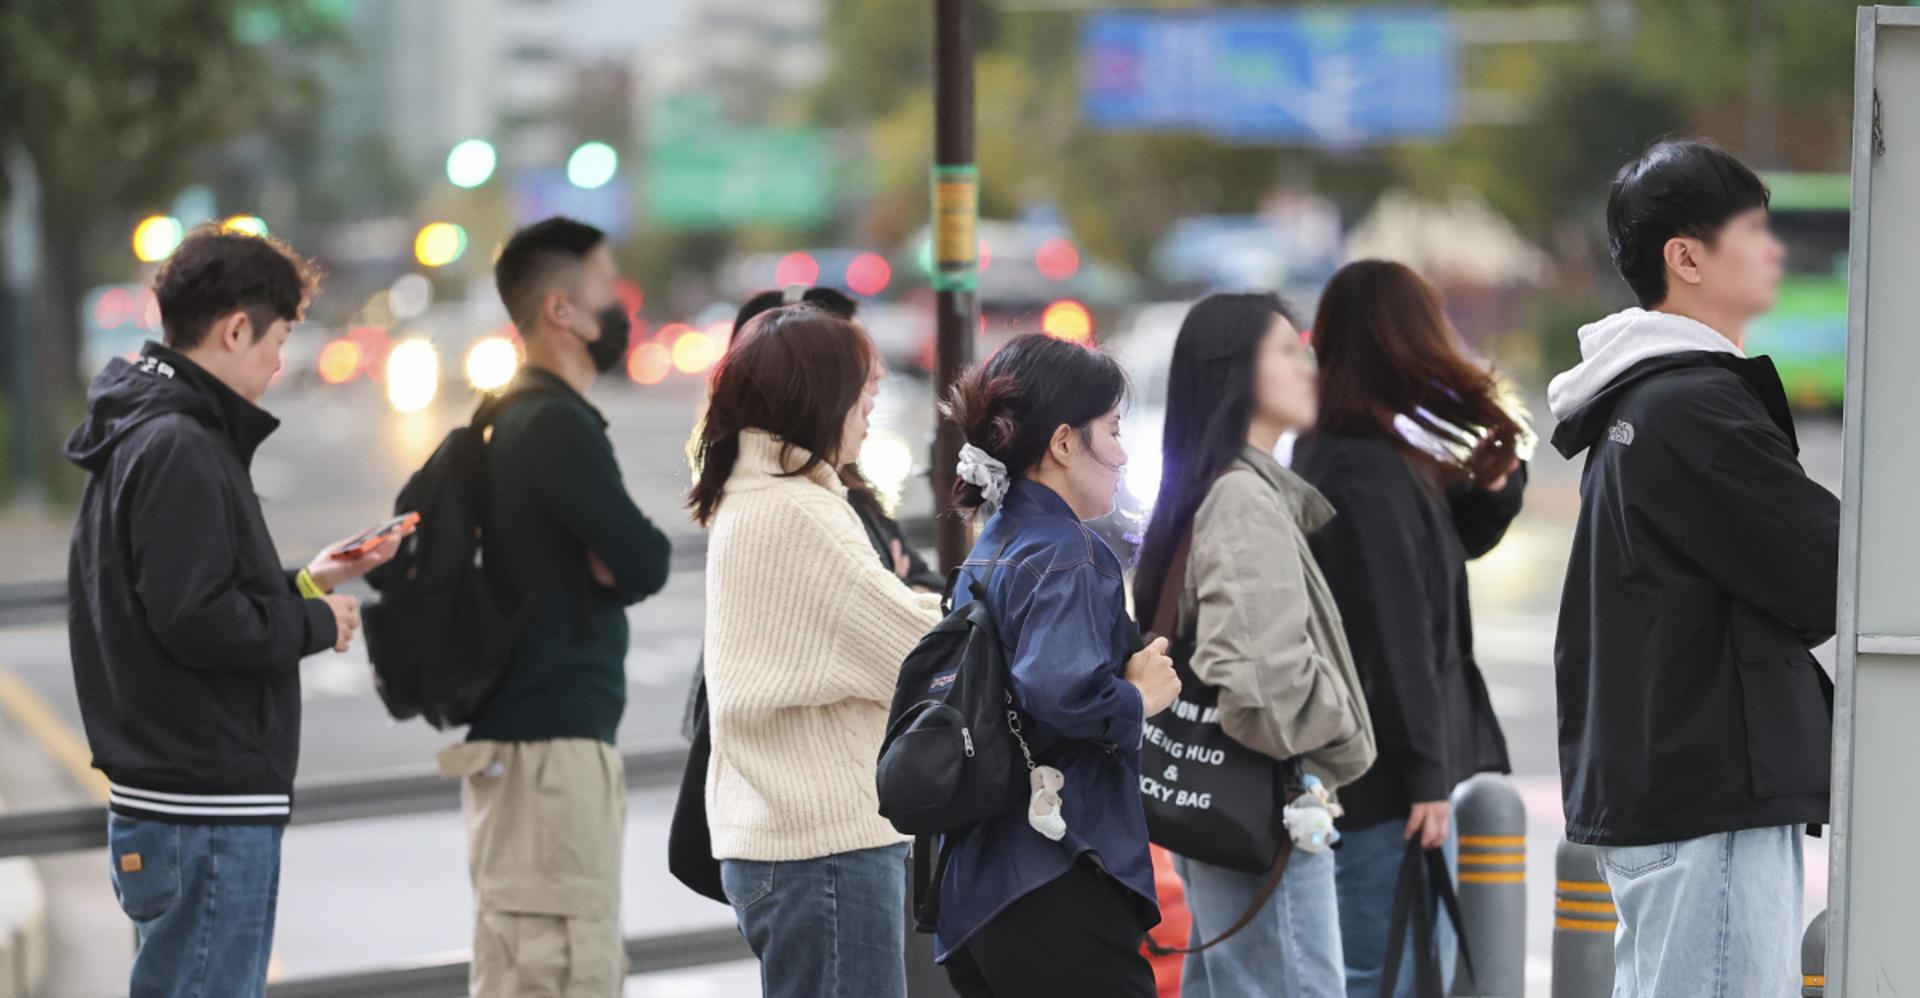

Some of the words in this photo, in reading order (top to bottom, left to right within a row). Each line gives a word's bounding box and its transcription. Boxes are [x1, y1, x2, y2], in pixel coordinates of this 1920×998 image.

[1185, 744, 1225, 766] HUO
[1163, 764, 1179, 782] &
[1138, 774, 1174, 802] CKY
[1175, 789, 1212, 809] BAG
